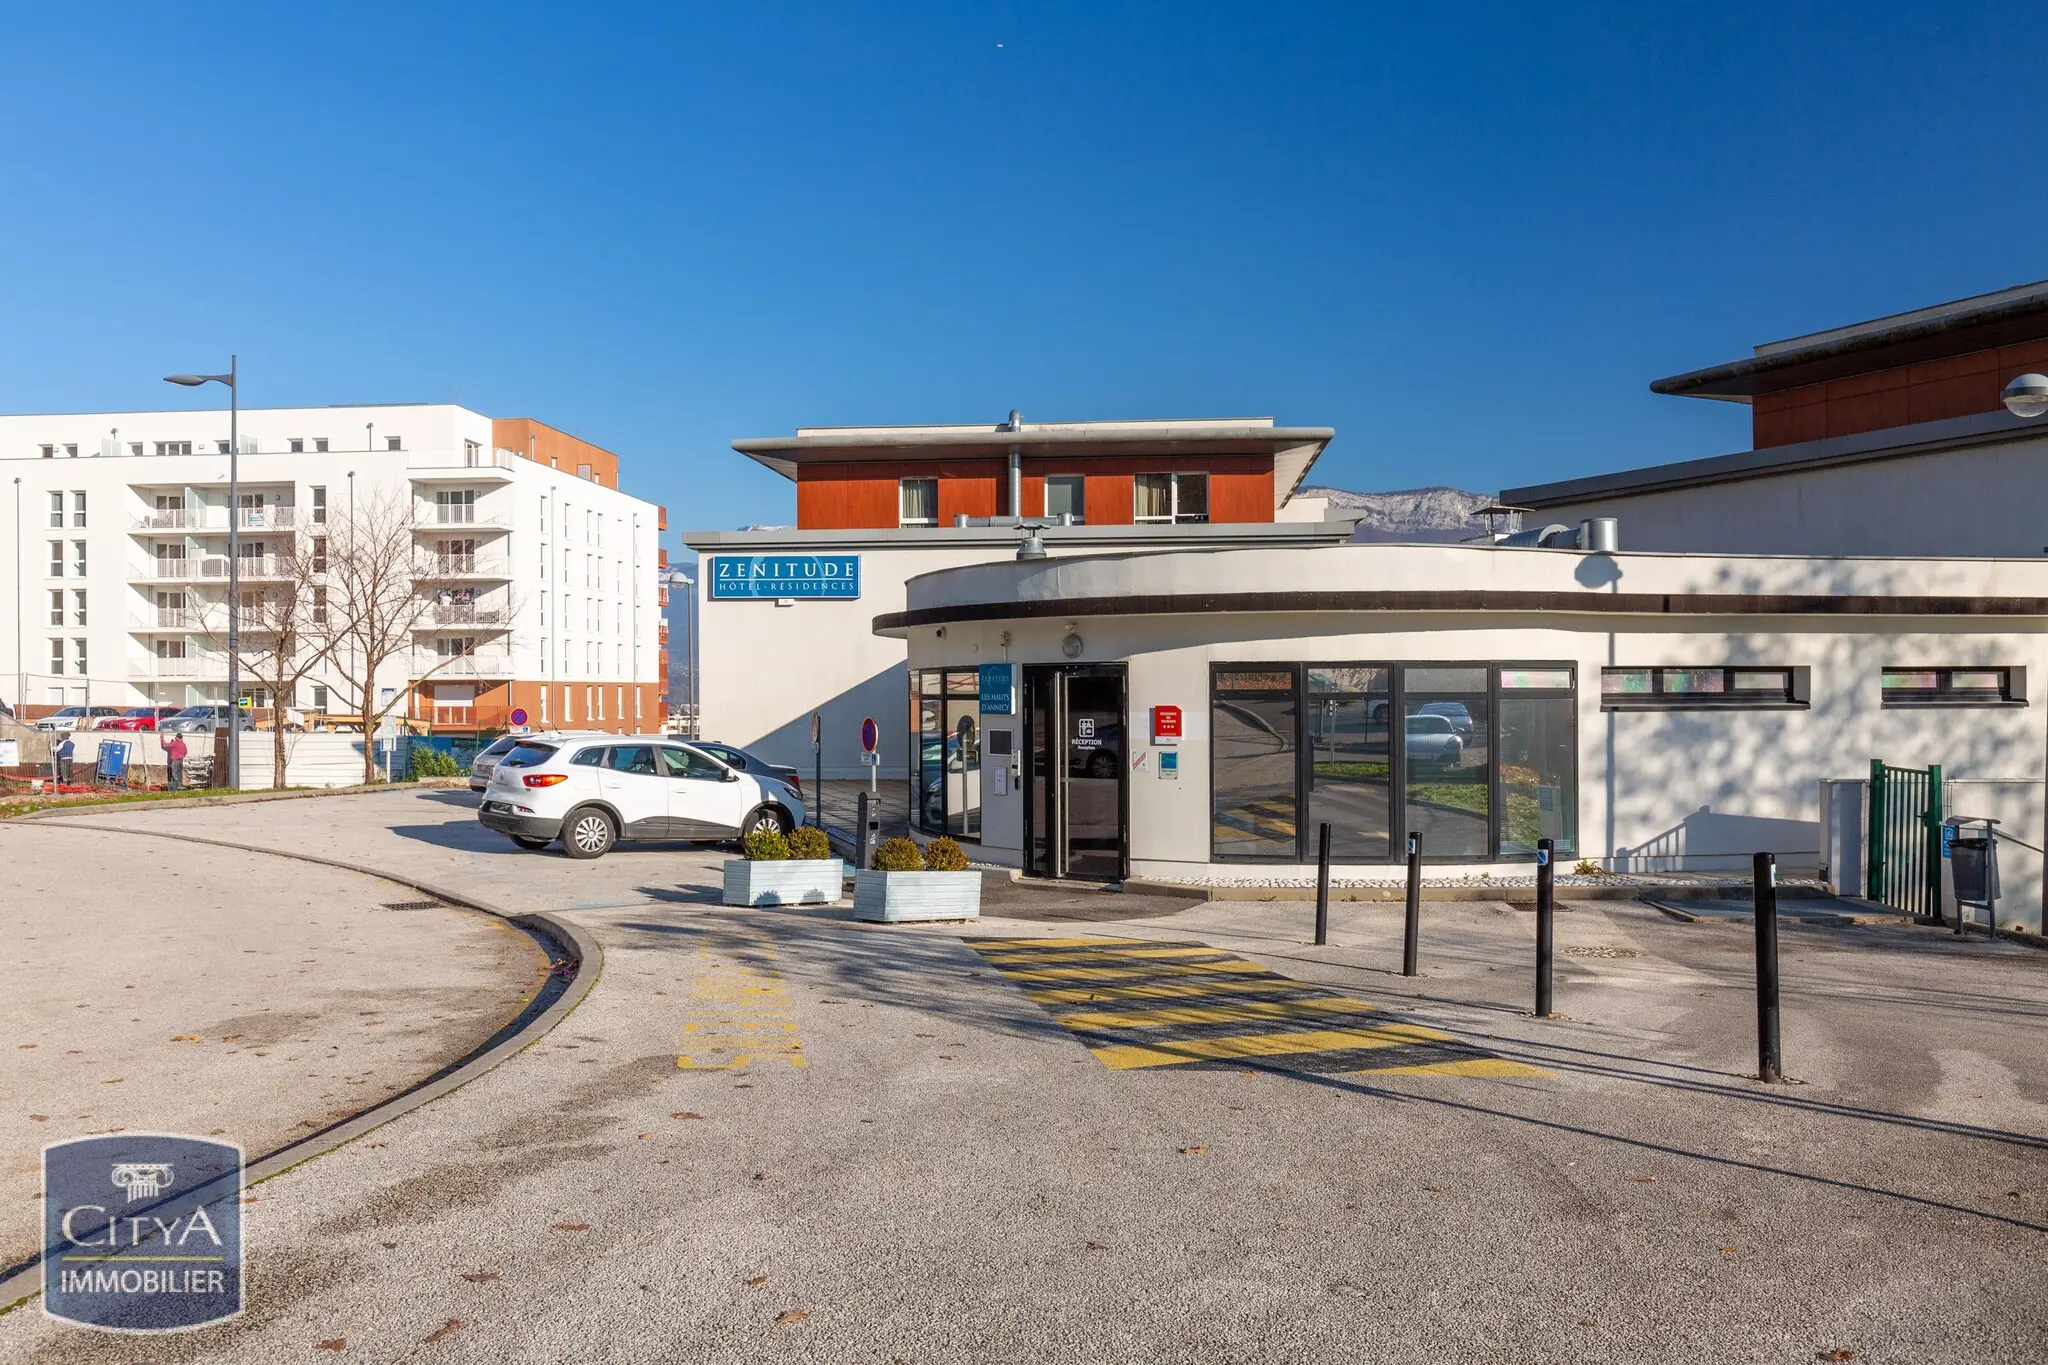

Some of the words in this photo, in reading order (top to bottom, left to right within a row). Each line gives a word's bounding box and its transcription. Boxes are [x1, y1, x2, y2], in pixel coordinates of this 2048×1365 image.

[719, 562, 854, 577] ZENITUDE
[719, 581, 854, 591] HÔTEL-RÉSIDENCES
[981, 693, 991, 701] LES
[991, 693, 1010, 701] HAUTS
[981, 703, 1010, 712] D'ANNECY
[1071, 737, 1102, 746] RÉCEPTION
